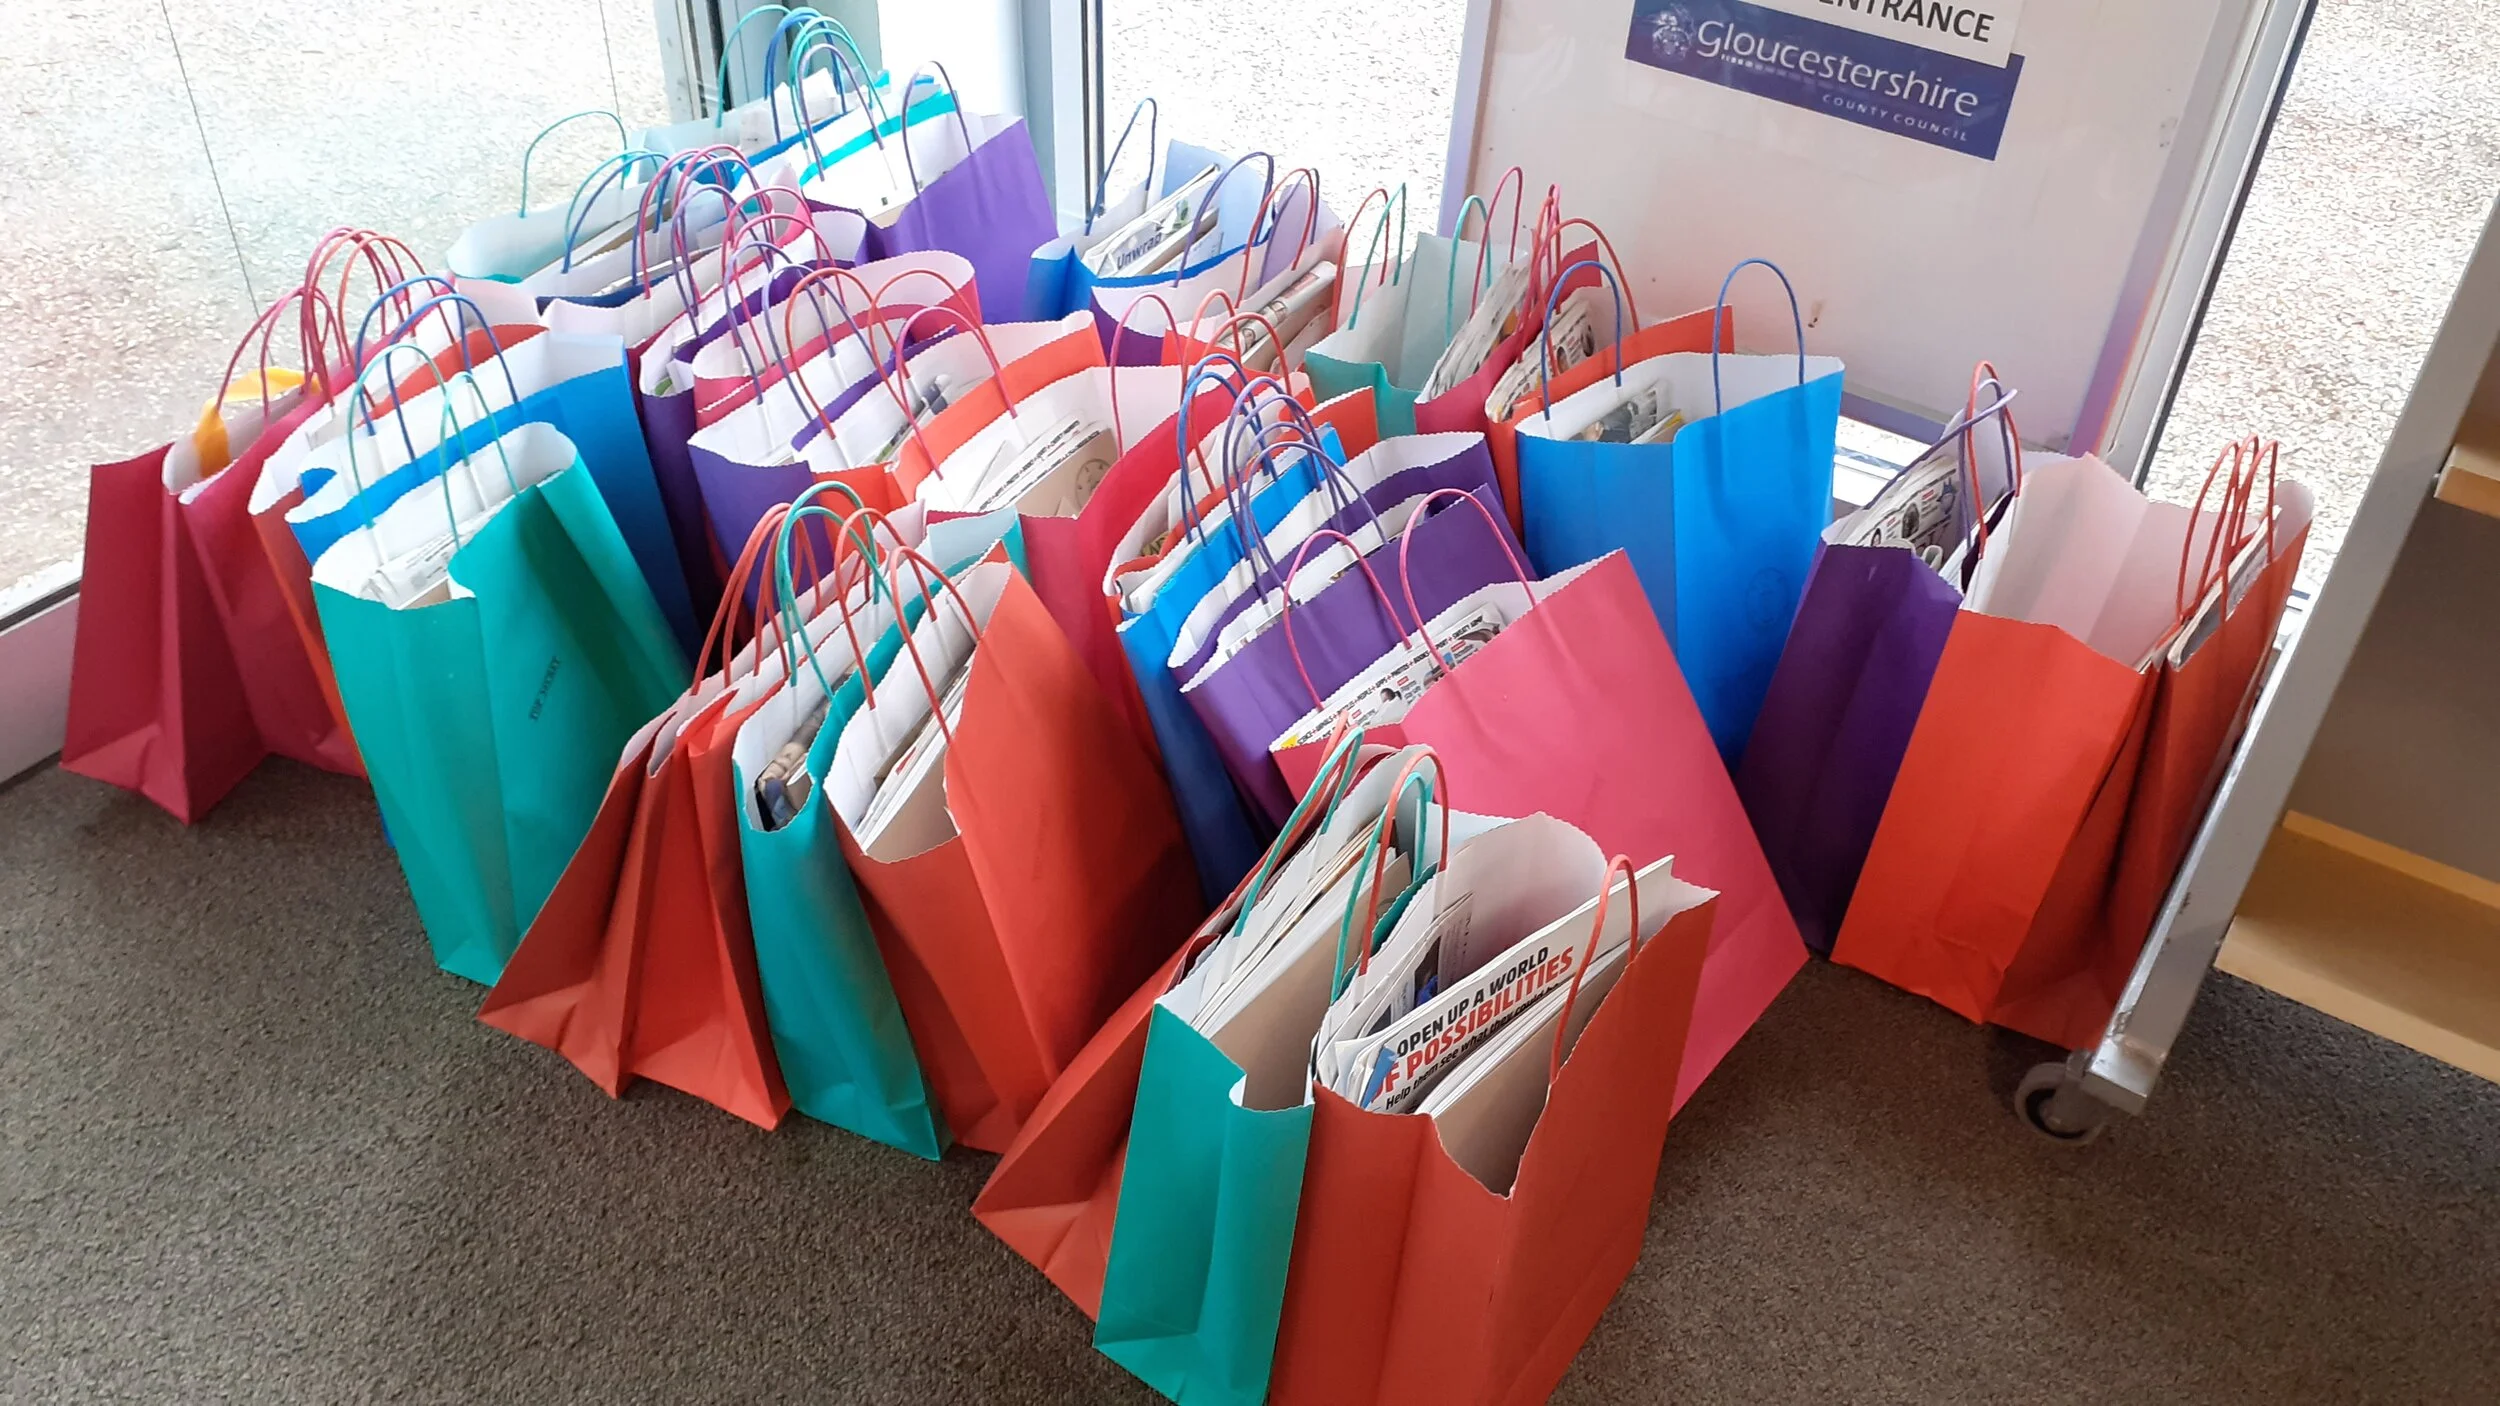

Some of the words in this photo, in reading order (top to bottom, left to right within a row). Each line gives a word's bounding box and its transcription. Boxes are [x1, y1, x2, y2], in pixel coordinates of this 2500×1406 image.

[1819, 0, 1994, 43] TRANCE
[1697, 20, 1979, 118] Gloucestershire
[1822, 94, 1888, 119] COUNTY
[1893, 113, 1967, 141] COUNCIL
[1371, 1061, 1400, 1103] F
[1406, 945, 1574, 1081] POSSIBILITIES
[1397, 1016, 1444, 1057] OPEN
[1448, 998, 1470, 1025] UP
[1473, 988, 1484, 1007] A
[1490, 946, 1549, 997] WORLD
[1386, 1085, 1411, 1110] Help
[1413, 1062, 1438, 1090] them
[1439, 1047, 1459, 1066] see
[1461, 1027, 1488, 1052] what
